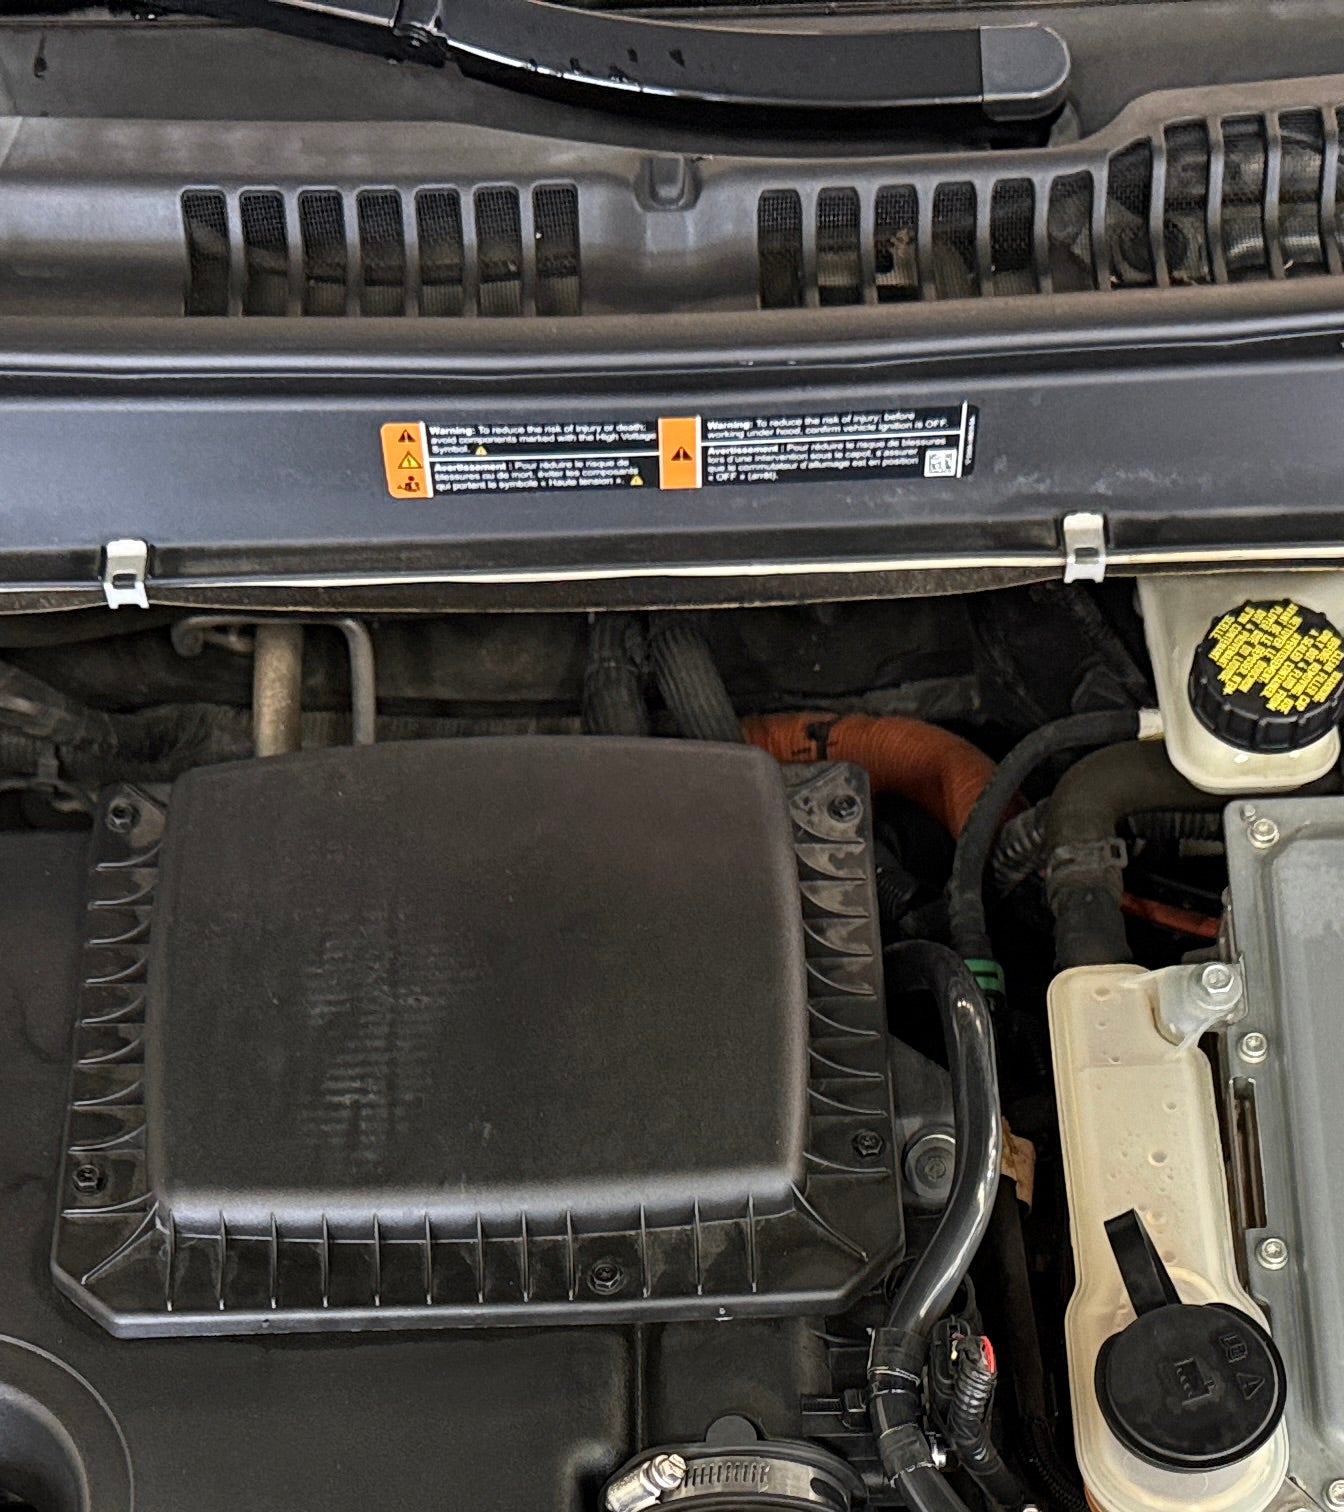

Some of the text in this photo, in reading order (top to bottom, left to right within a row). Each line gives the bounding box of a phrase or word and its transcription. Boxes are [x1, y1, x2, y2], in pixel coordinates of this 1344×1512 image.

[707, 421, 753, 430] Warning:
[769, 419, 802, 427] reduce
[804, 416, 820, 425] the
[822, 416, 839, 424] risk
[884, 412, 915, 420] before
[429, 427, 476, 436] Warning:
[492, 426, 525, 434] reduce
[544, 425, 562, 433] risk
[575, 424, 602, 434] injury
[707, 431, 744, 439] working
[746, 429, 774, 437] under
[843, 423, 876, 432] vehicle
[878, 422, 912, 432] ignition
[557, 434, 577, 442] with
[596, 432, 619, 442] High
[620, 432, 656, 441] Voltage
[708, 445, 778, 455] Avertissement
[856, 441, 885, 449] risque
[901, 437, 946, 446] blessures
[708, 456, 725, 464] lors
[755, 454, 808, 462] intervention
[738, 463, 798, 471] commutateur
[852, 460, 866, 468] est
[882, 458, 919, 467] position
[434, 463, 506, 472] Avertissement
[514, 462, 537, 470] Pour
[585, 460, 615, 468] risque
[435, 472, 480, 481] blessures
[582, 467, 638, 477] composants
[716, 473, 737, 481] OFF
[436, 482, 451, 491] qui
[453, 481, 486, 491] portent
[498, 480, 538, 490] symbole
[548, 479, 577, 487] Haute
